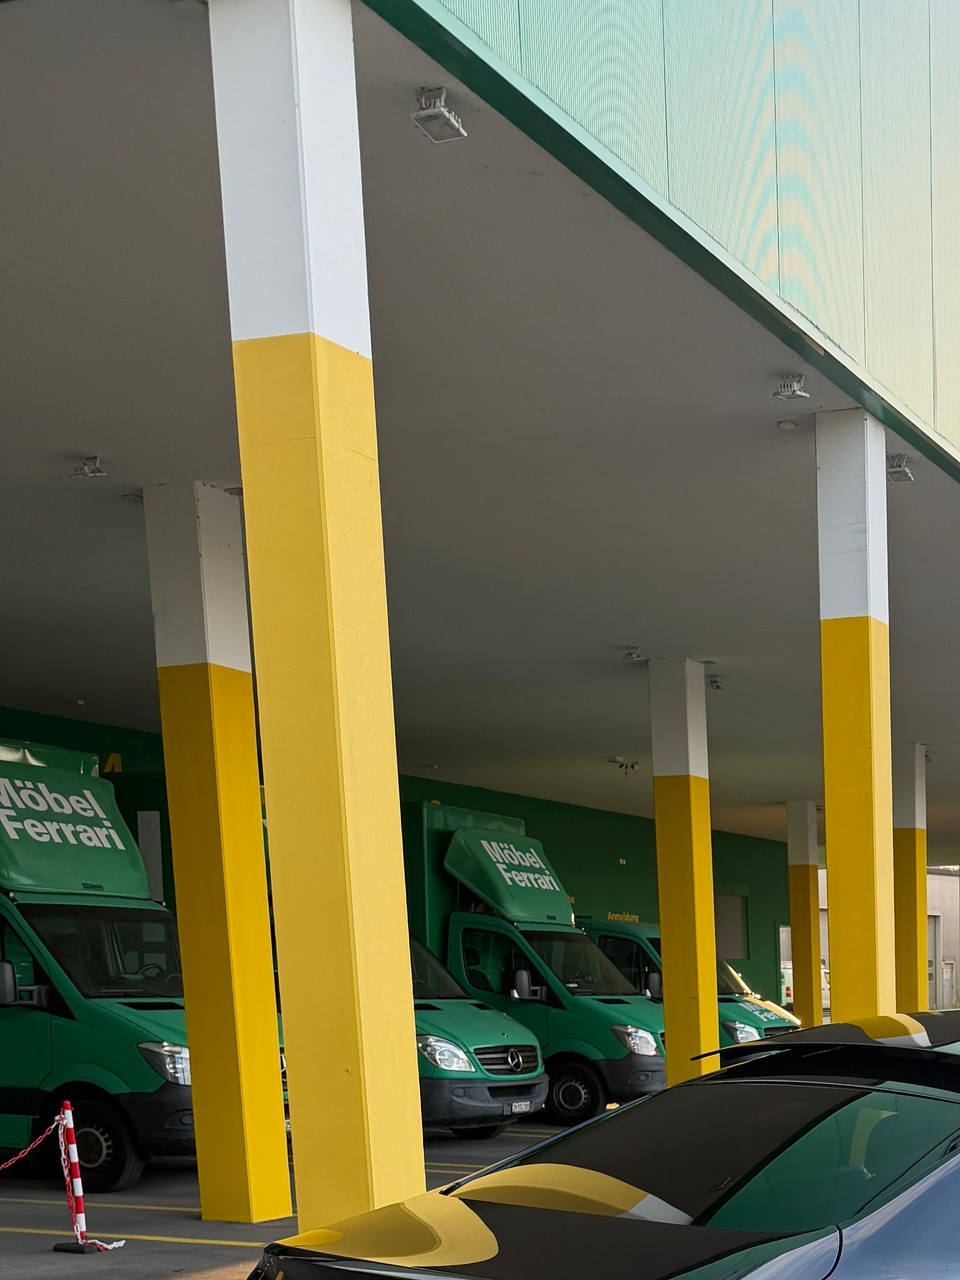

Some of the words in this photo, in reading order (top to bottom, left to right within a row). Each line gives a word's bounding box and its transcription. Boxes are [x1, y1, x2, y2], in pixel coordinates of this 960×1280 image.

[0, 808, 126, 850] Ferrari
[480, 840, 546, 869] Möbel
[495, 863, 560, 891] Ferrari
